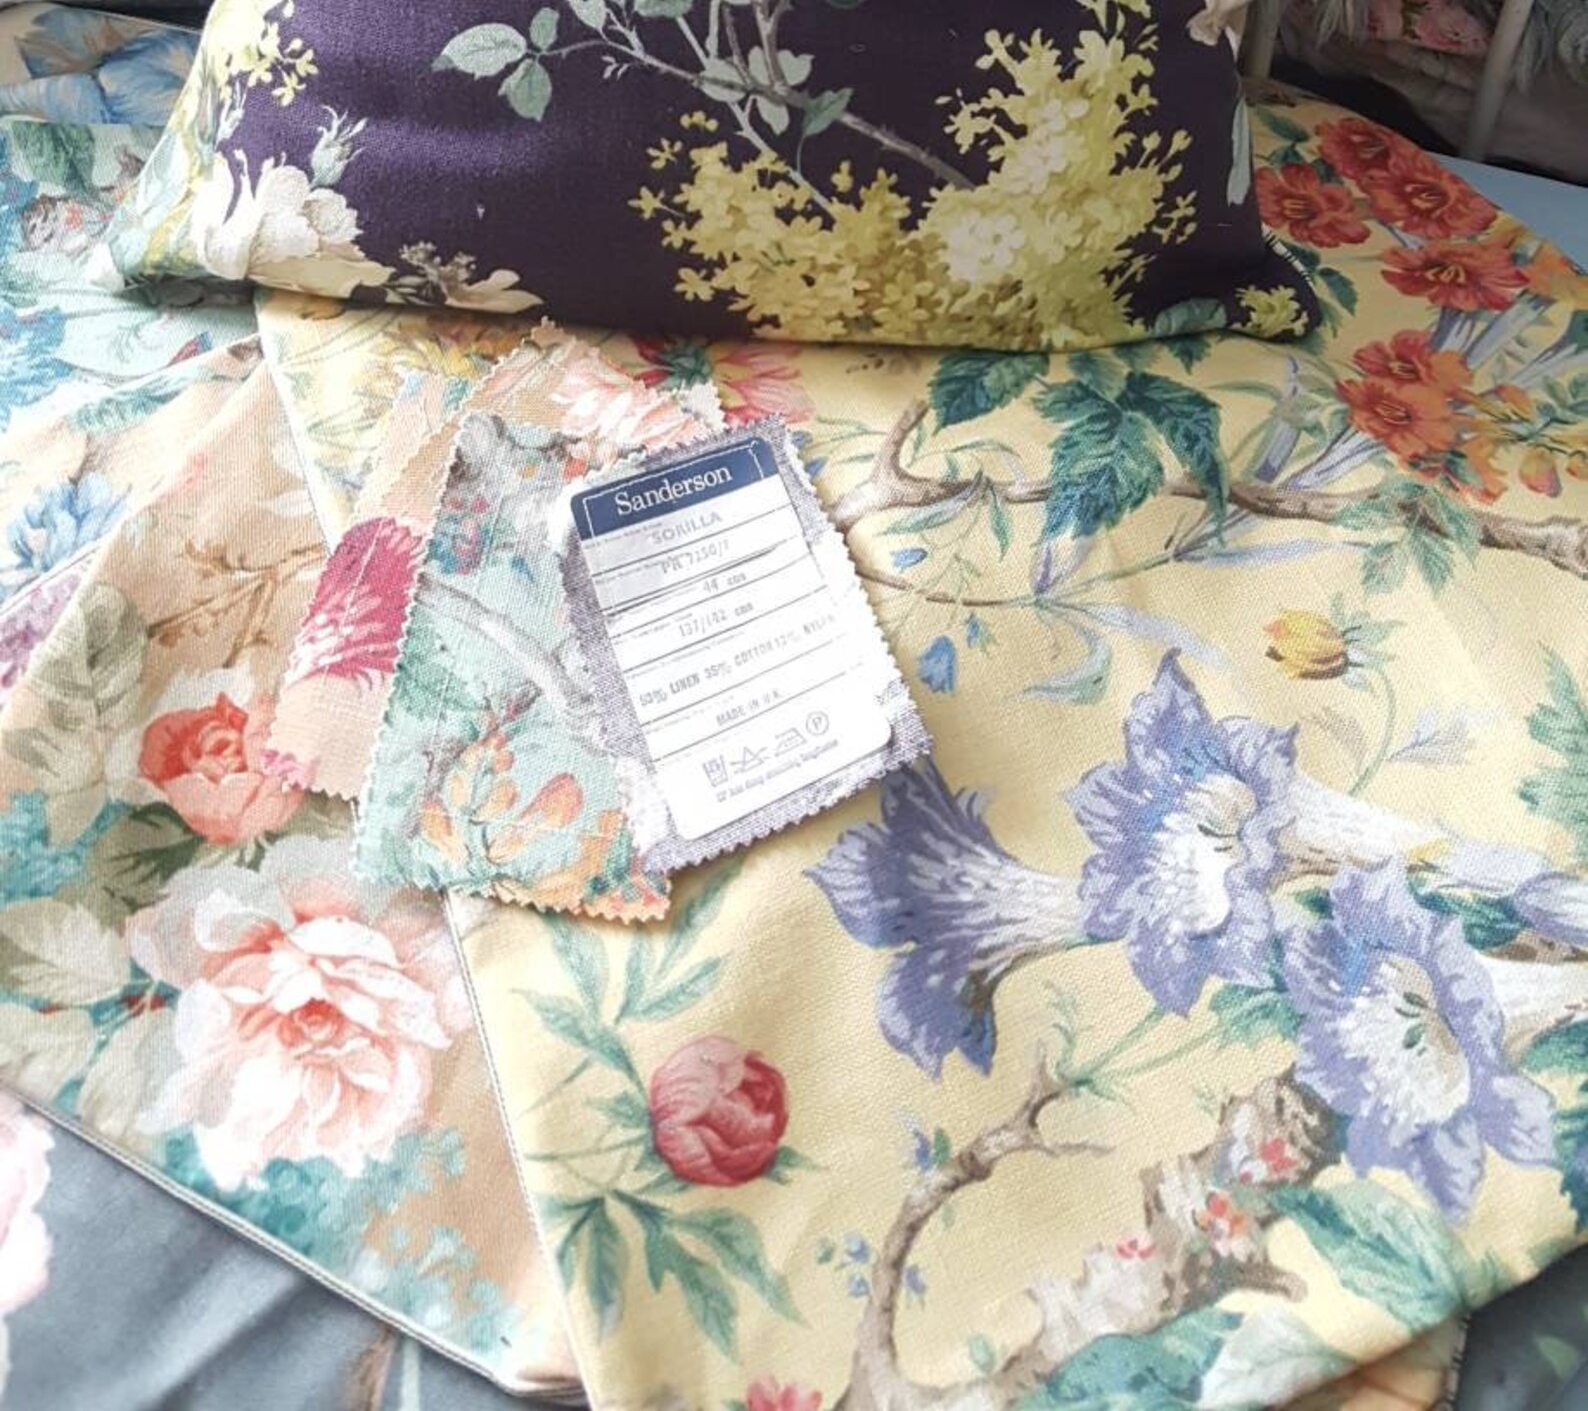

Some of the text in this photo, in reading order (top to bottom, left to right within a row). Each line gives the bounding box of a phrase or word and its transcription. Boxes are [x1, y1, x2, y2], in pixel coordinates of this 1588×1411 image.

[615, 467, 733, 516] Sanderson
[652, 511, 722, 545] SORILLA
[669, 671, 700, 694] LINEN
[735, 642, 774, 667] COTTON
[716, 705, 746, 726] MADE
